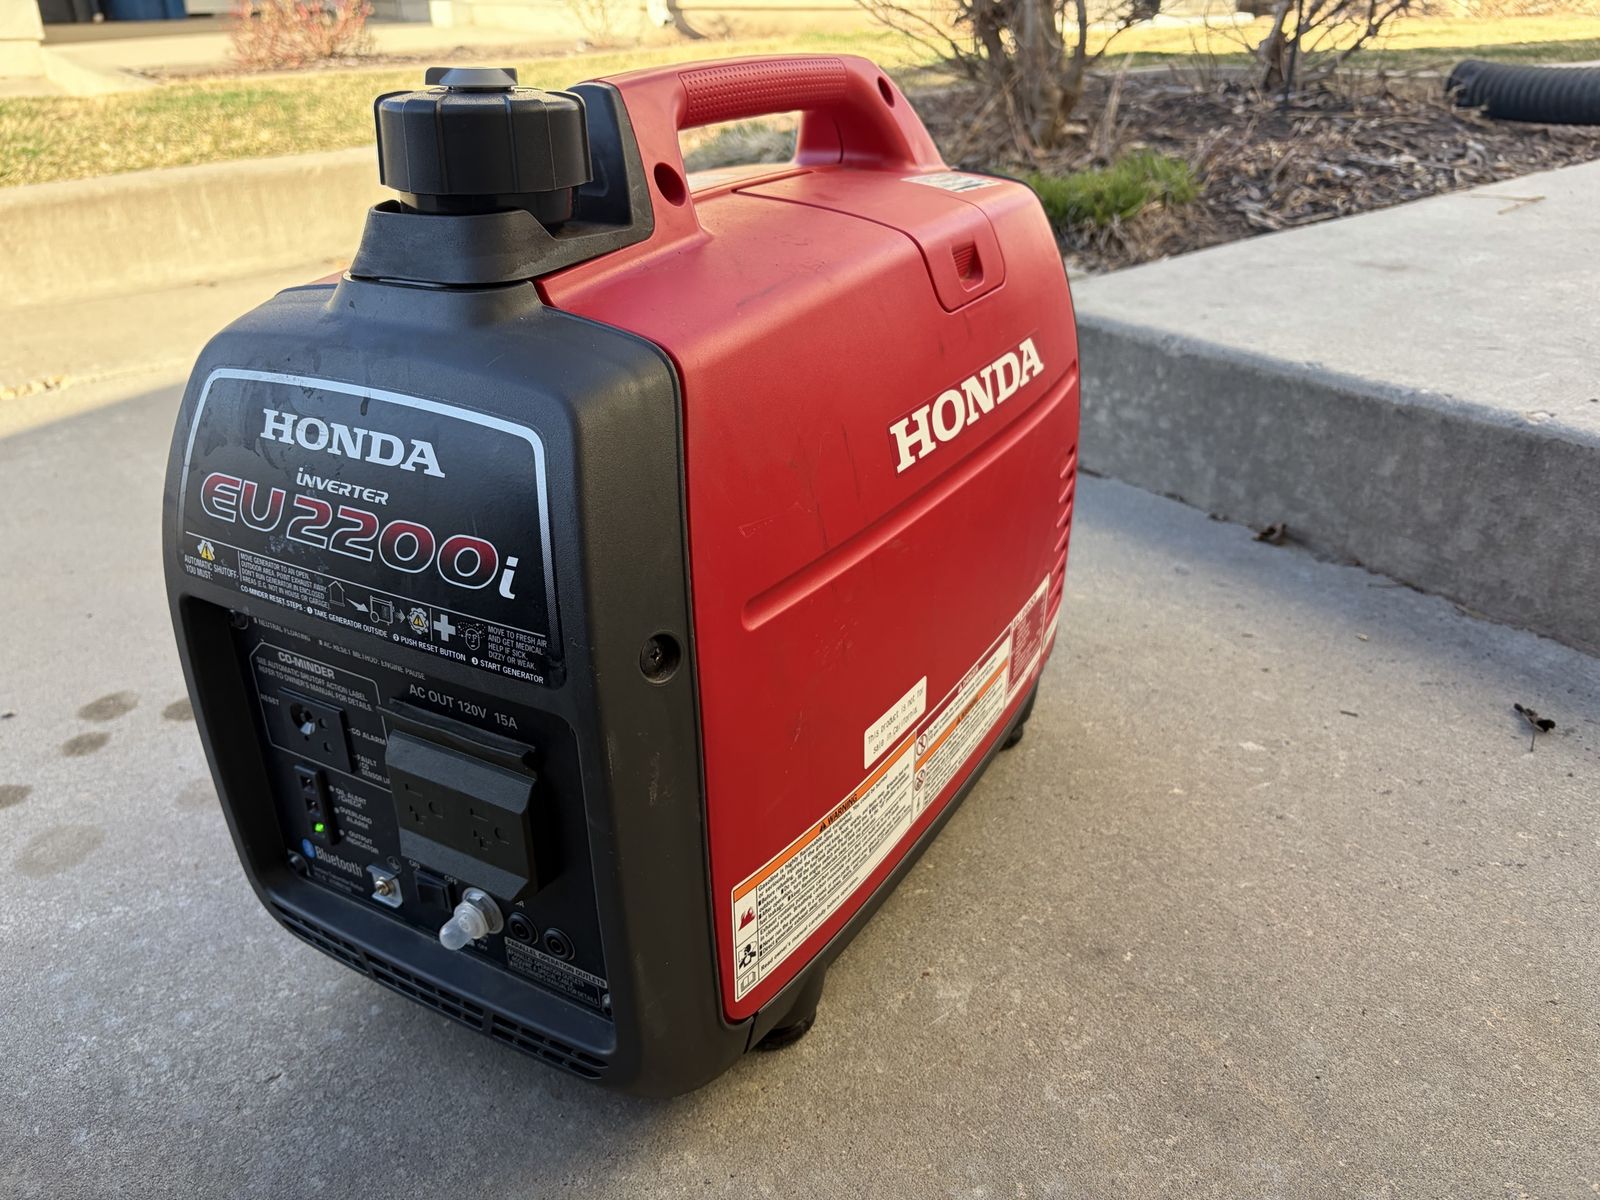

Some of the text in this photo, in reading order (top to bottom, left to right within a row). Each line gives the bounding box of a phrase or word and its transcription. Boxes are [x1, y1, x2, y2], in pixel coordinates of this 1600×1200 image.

[890, 338, 1044, 473] HONDA
[260, 408, 446, 478] HONDA
[200, 471, 518, 600] EU2200i
[184, 553, 212, 571] AUTOMATIC
[269, 593, 284, 605] RESET
[314, 608, 327, 619] TAKE
[328, 612, 361, 630] GENERATOR
[362, 623, 387, 638] OUTSIDE
[400, 635, 416, 647] PUSH
[418, 640, 437, 653] RESET
[439, 646, 465, 661] BUTTON
[480, 658, 500, 671] START
[502, 665, 543, 683] GENERATOR
[487, 624, 547, 648] MOVE TO FRESH AIR
[487, 633, 500, 644] AND
[502, 637, 514, 647] GET
[488, 641, 503, 653] HELP
[504, 646, 510, 654] IF
[278, 650, 334, 680] CO-MINDER
[488, 650, 505, 661] DIZZY
[506, 655, 515, 664] OR
[404, 666, 426, 681] PAUSE
[409, 683, 519, 730] AC OUT 120V 15A
[880, 710, 899, 733] product
[827, 793, 858, 825] WARNING
[315, 845, 363, 878] Bluetooth
